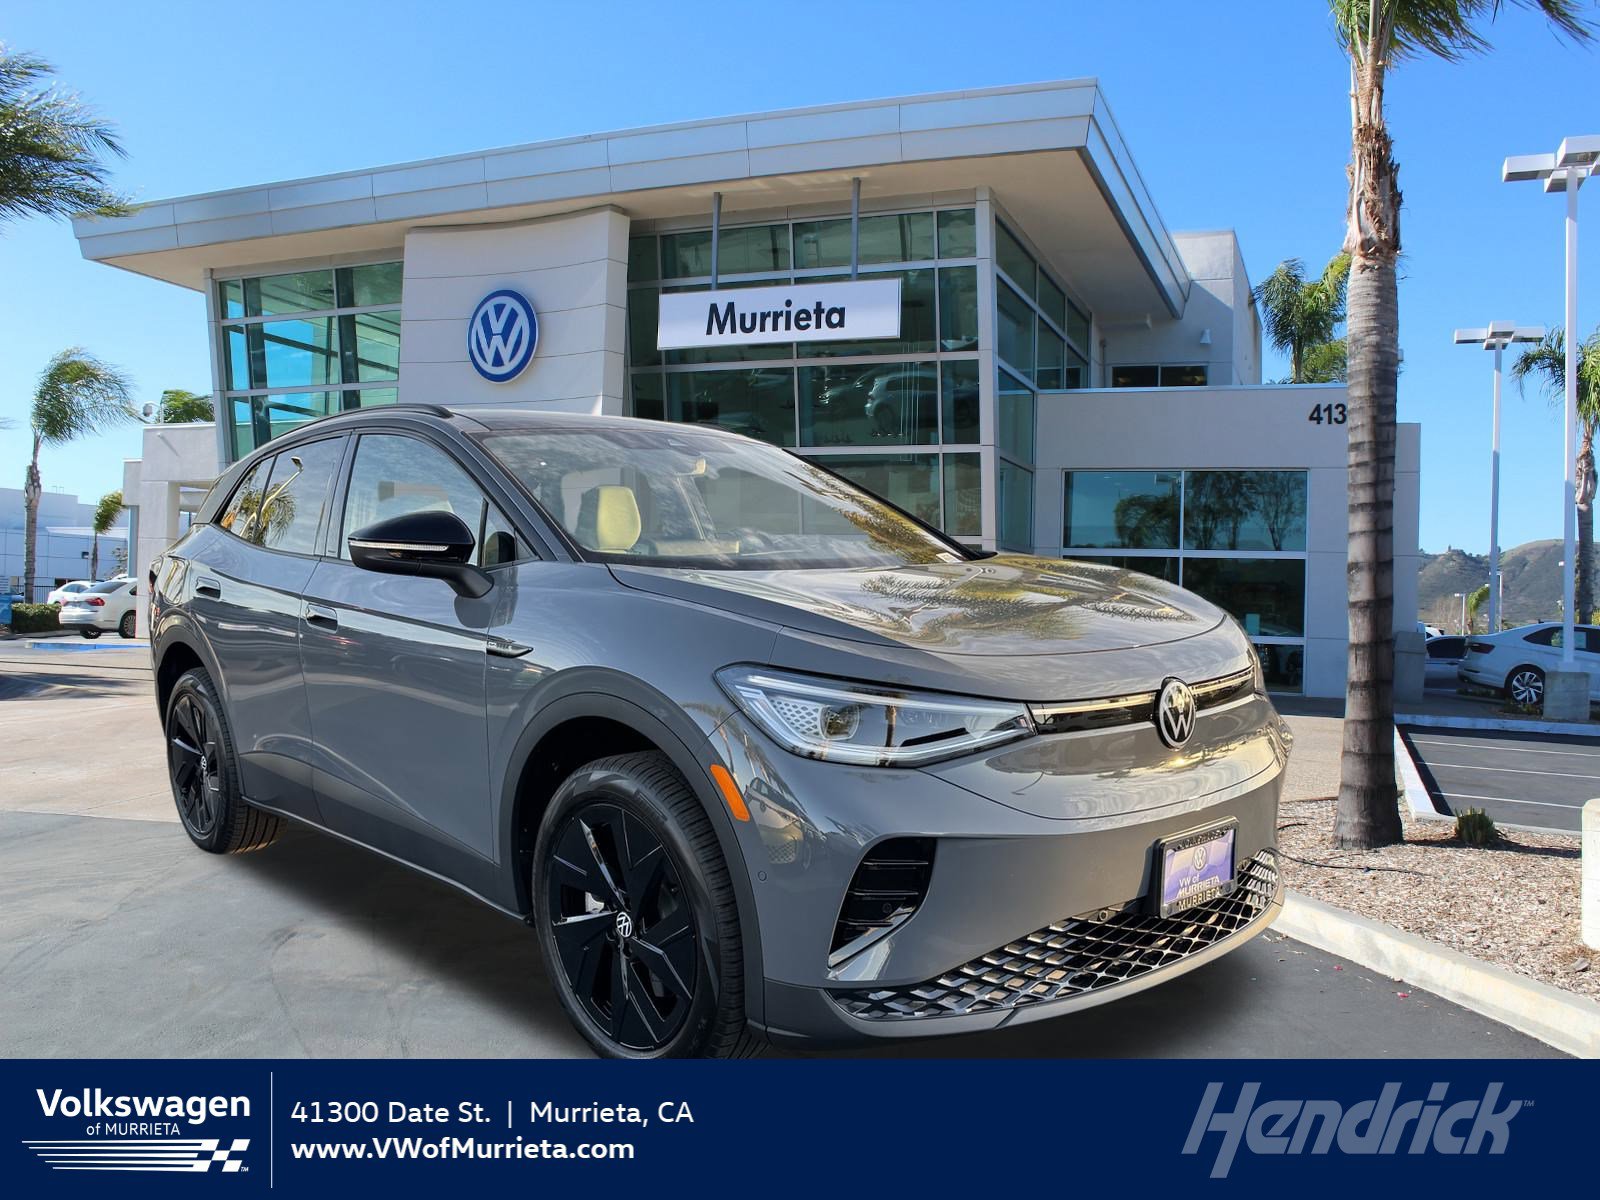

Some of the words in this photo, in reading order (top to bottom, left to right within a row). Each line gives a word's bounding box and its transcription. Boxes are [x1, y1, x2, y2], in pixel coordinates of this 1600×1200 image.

[705, 299, 847, 336] Murrieta
[1308, 403, 1347, 425] 413
[1178, 875, 1220, 897] MURRIETA
[1178, 887, 1221, 911] MURRIETA
